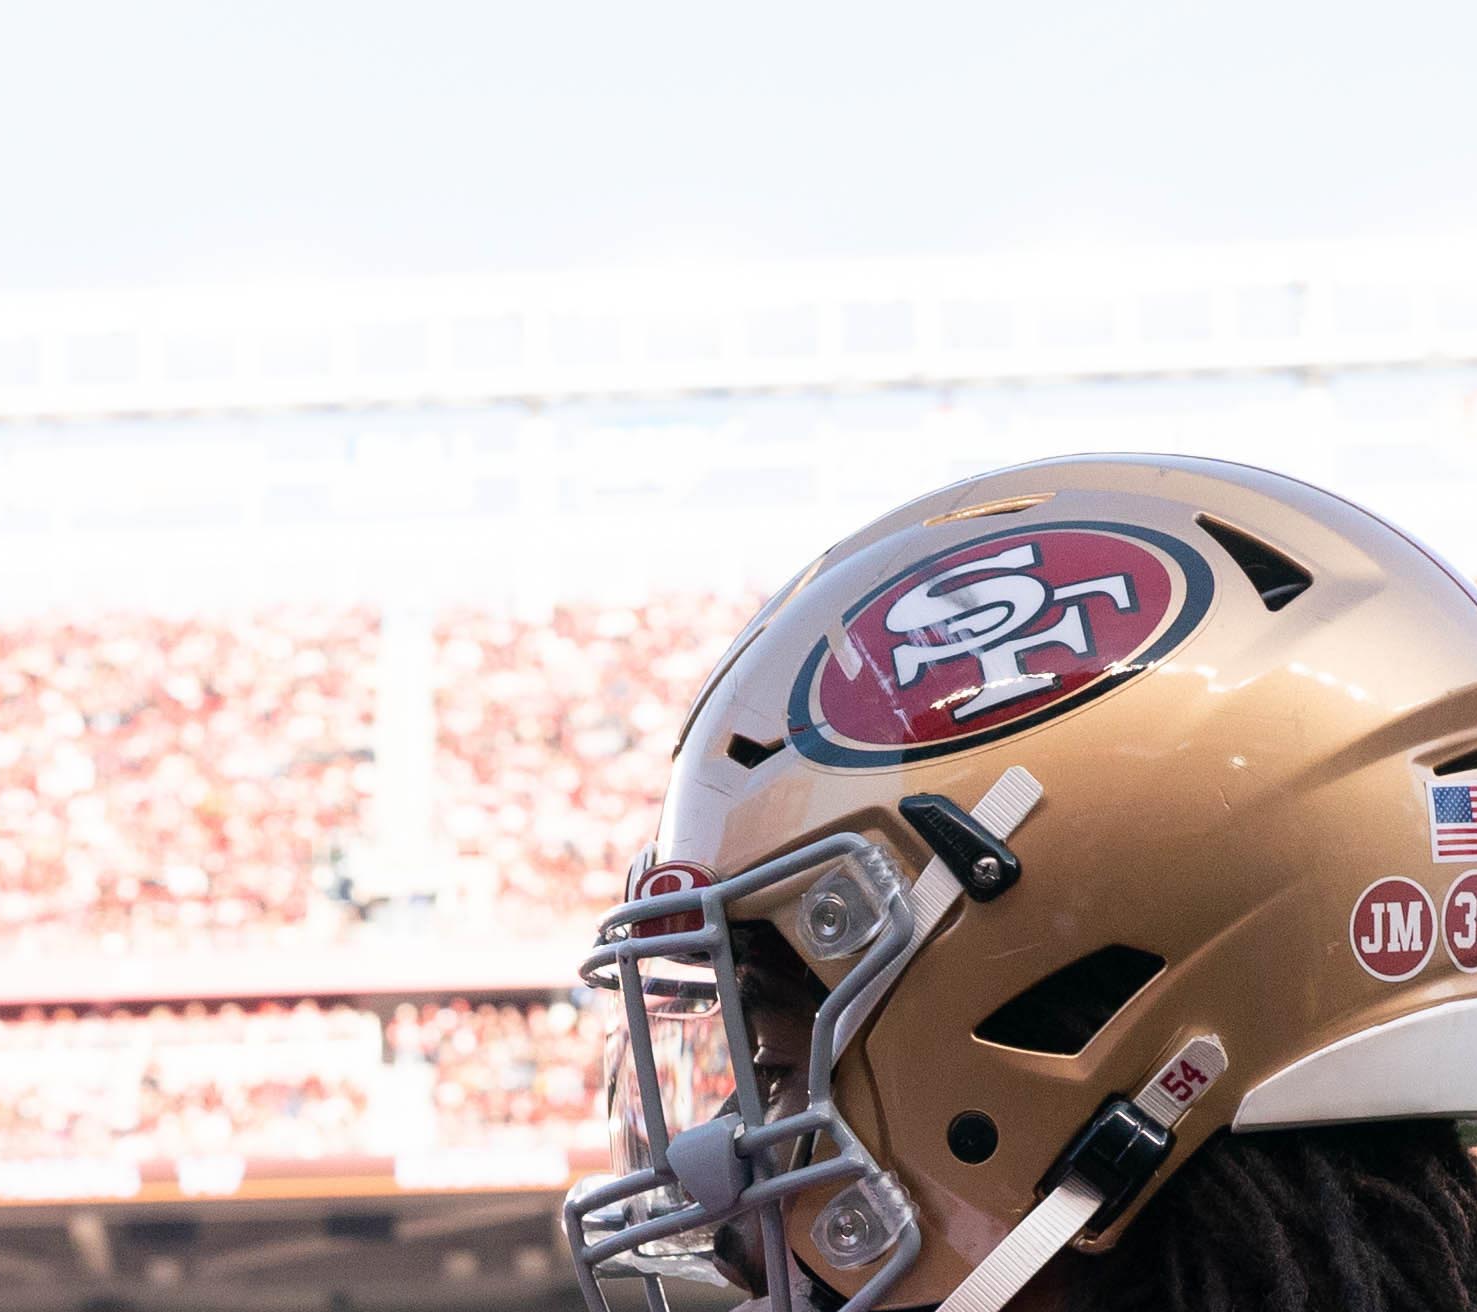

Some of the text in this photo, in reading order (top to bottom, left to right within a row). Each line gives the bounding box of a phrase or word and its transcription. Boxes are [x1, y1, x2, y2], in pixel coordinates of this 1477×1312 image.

[885, 543, 1140, 724] SF
[1361, 901, 1423, 953] JM
[1160, 1060, 1208, 1101] 54
